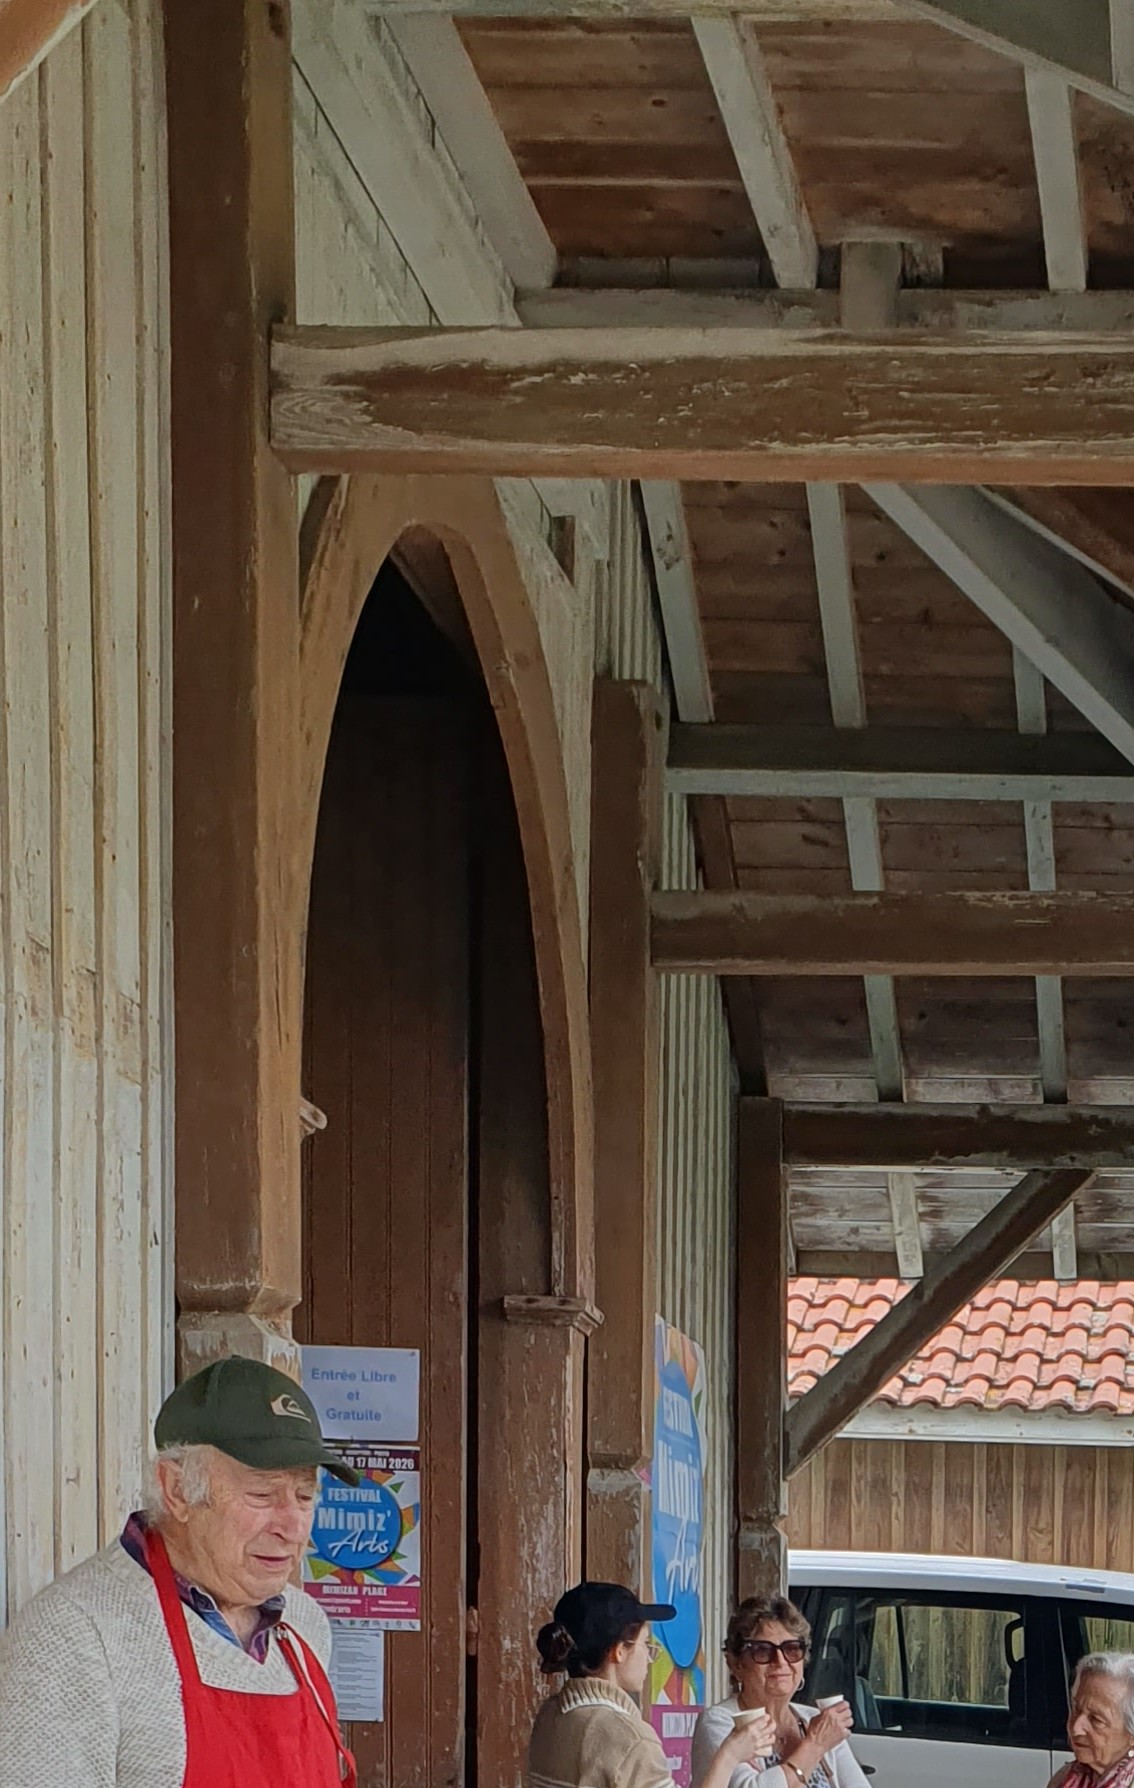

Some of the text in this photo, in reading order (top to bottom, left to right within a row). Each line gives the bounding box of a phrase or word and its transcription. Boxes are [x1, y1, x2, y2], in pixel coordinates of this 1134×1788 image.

[312, 1368, 396, 1382] Entrée Libre
[347, 1391, 359, 1400] et
[327, 1408, 381, 1421] Gratuite
[357, 1458, 366, 1468] 17
[368, 1458, 386, 1468] MAI
[389, 1459, 414, 1469] 2026
[328, 1488, 382, 1503] FESTIVAL
[328, 1531, 390, 1558] Arts
